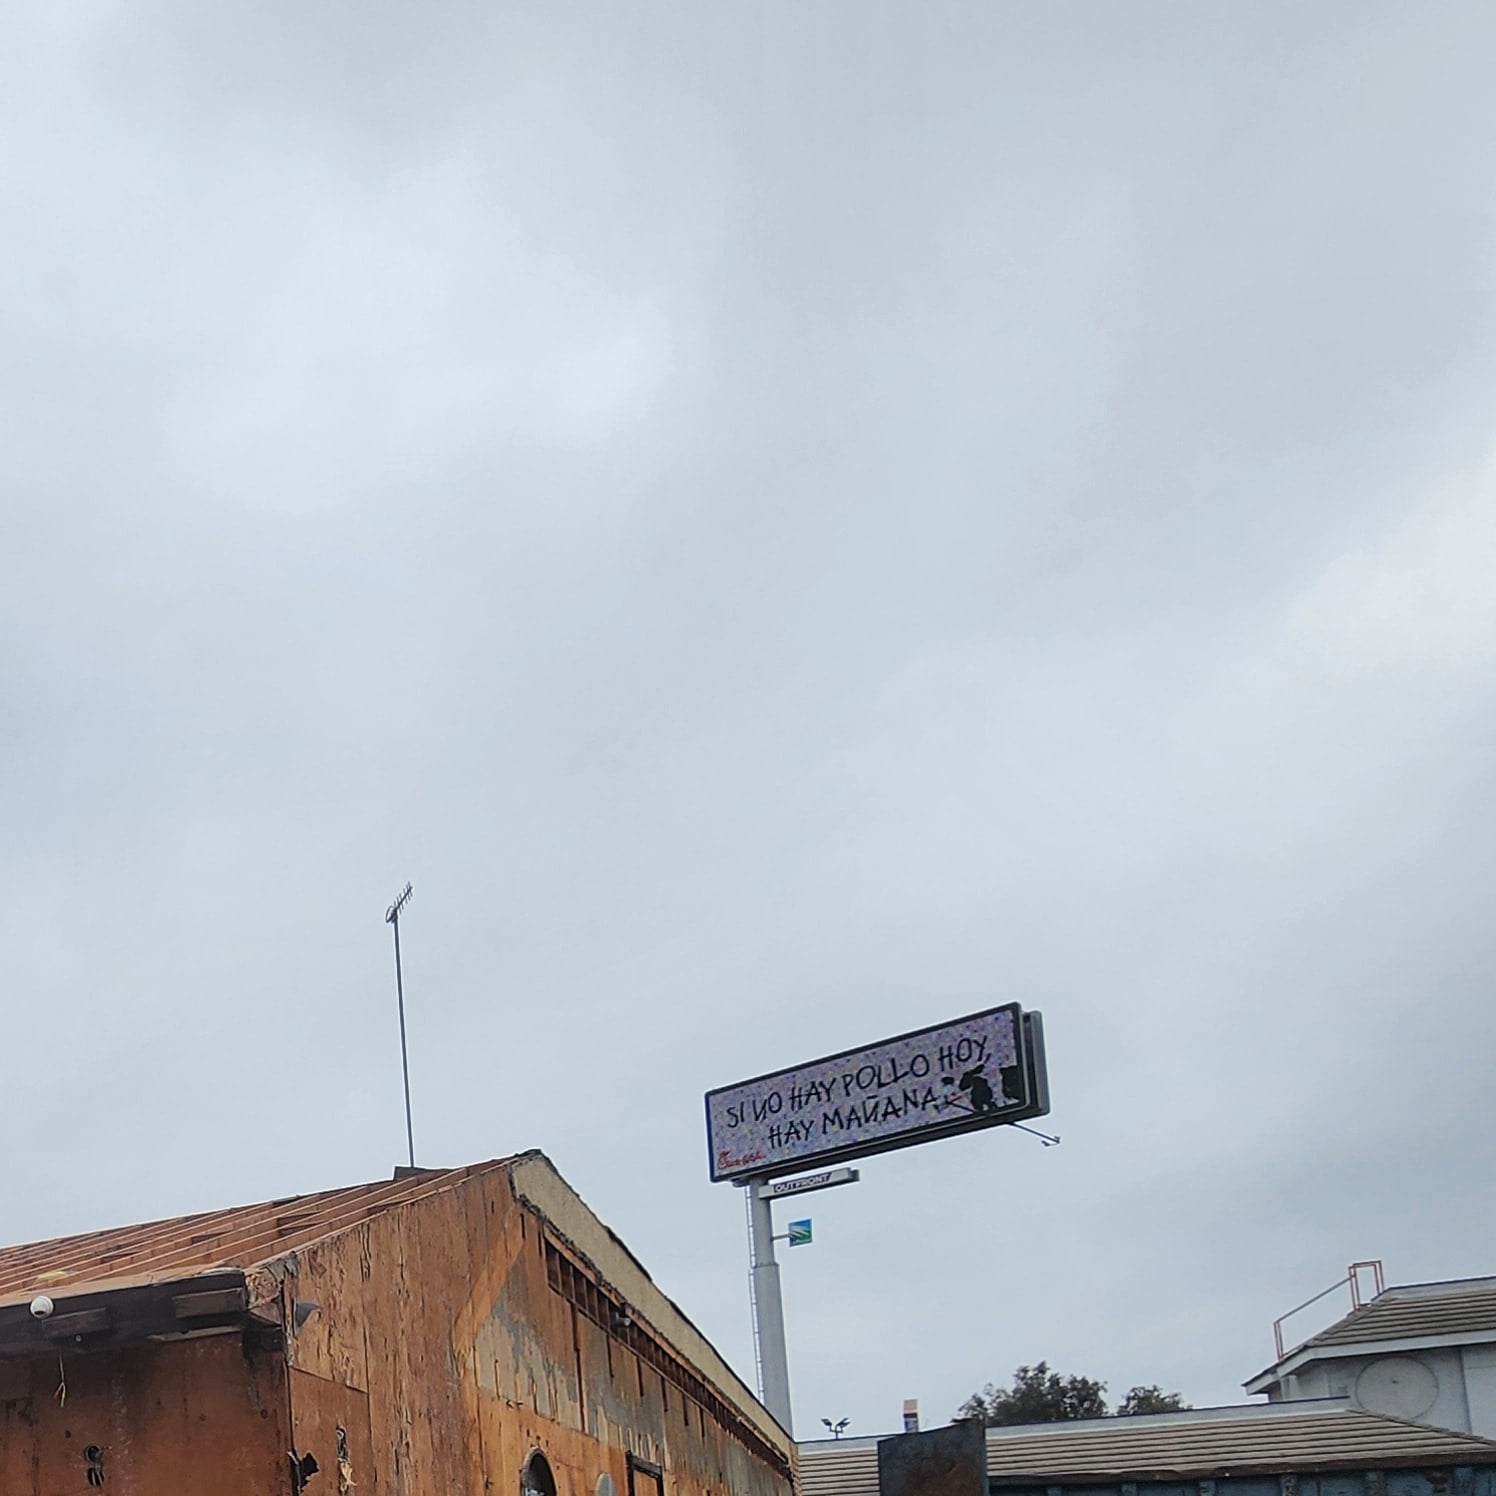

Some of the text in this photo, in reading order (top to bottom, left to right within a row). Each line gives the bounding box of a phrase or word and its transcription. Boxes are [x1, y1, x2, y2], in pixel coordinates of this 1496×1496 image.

[726, 1100, 745, 1128] SI
[789, 1078, 837, 1112] HAY
[841, 1053, 930, 1098] POLLO
[937, 1035, 992, 1072] HOY,
[767, 1120, 815, 1150] HAY
[775, 1173, 830, 1193] OUTFRONT
